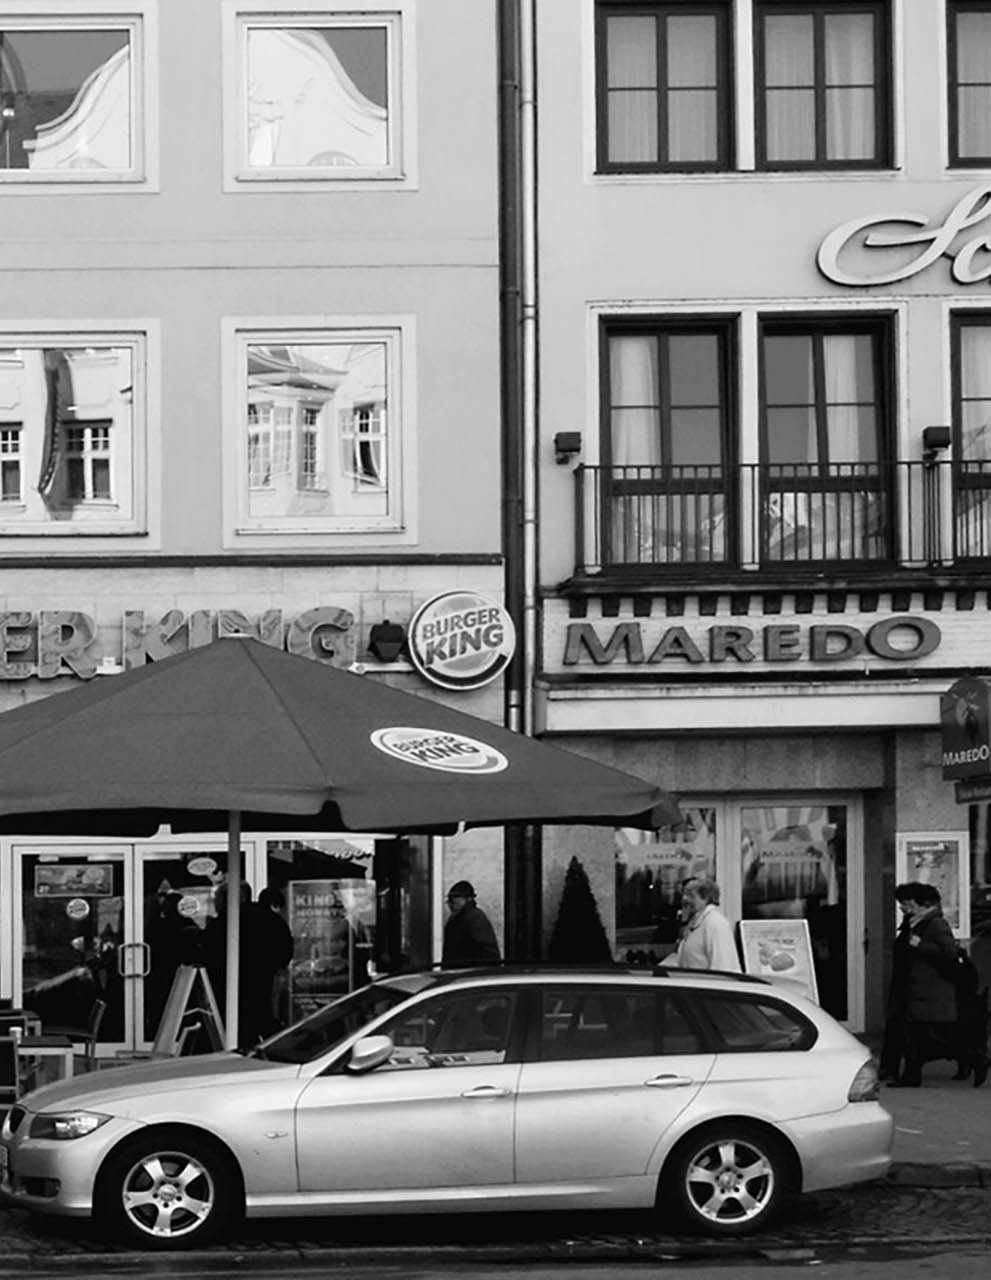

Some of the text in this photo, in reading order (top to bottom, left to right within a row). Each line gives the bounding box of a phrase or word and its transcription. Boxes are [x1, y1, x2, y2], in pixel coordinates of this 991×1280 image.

[422, 607, 501, 642] BURGER
[562, 615, 942, 665] MAREDO
[425, 623, 504, 666] KING
[409, 742, 480, 762] KING
[942, 744, 989, 766] MAREDO
